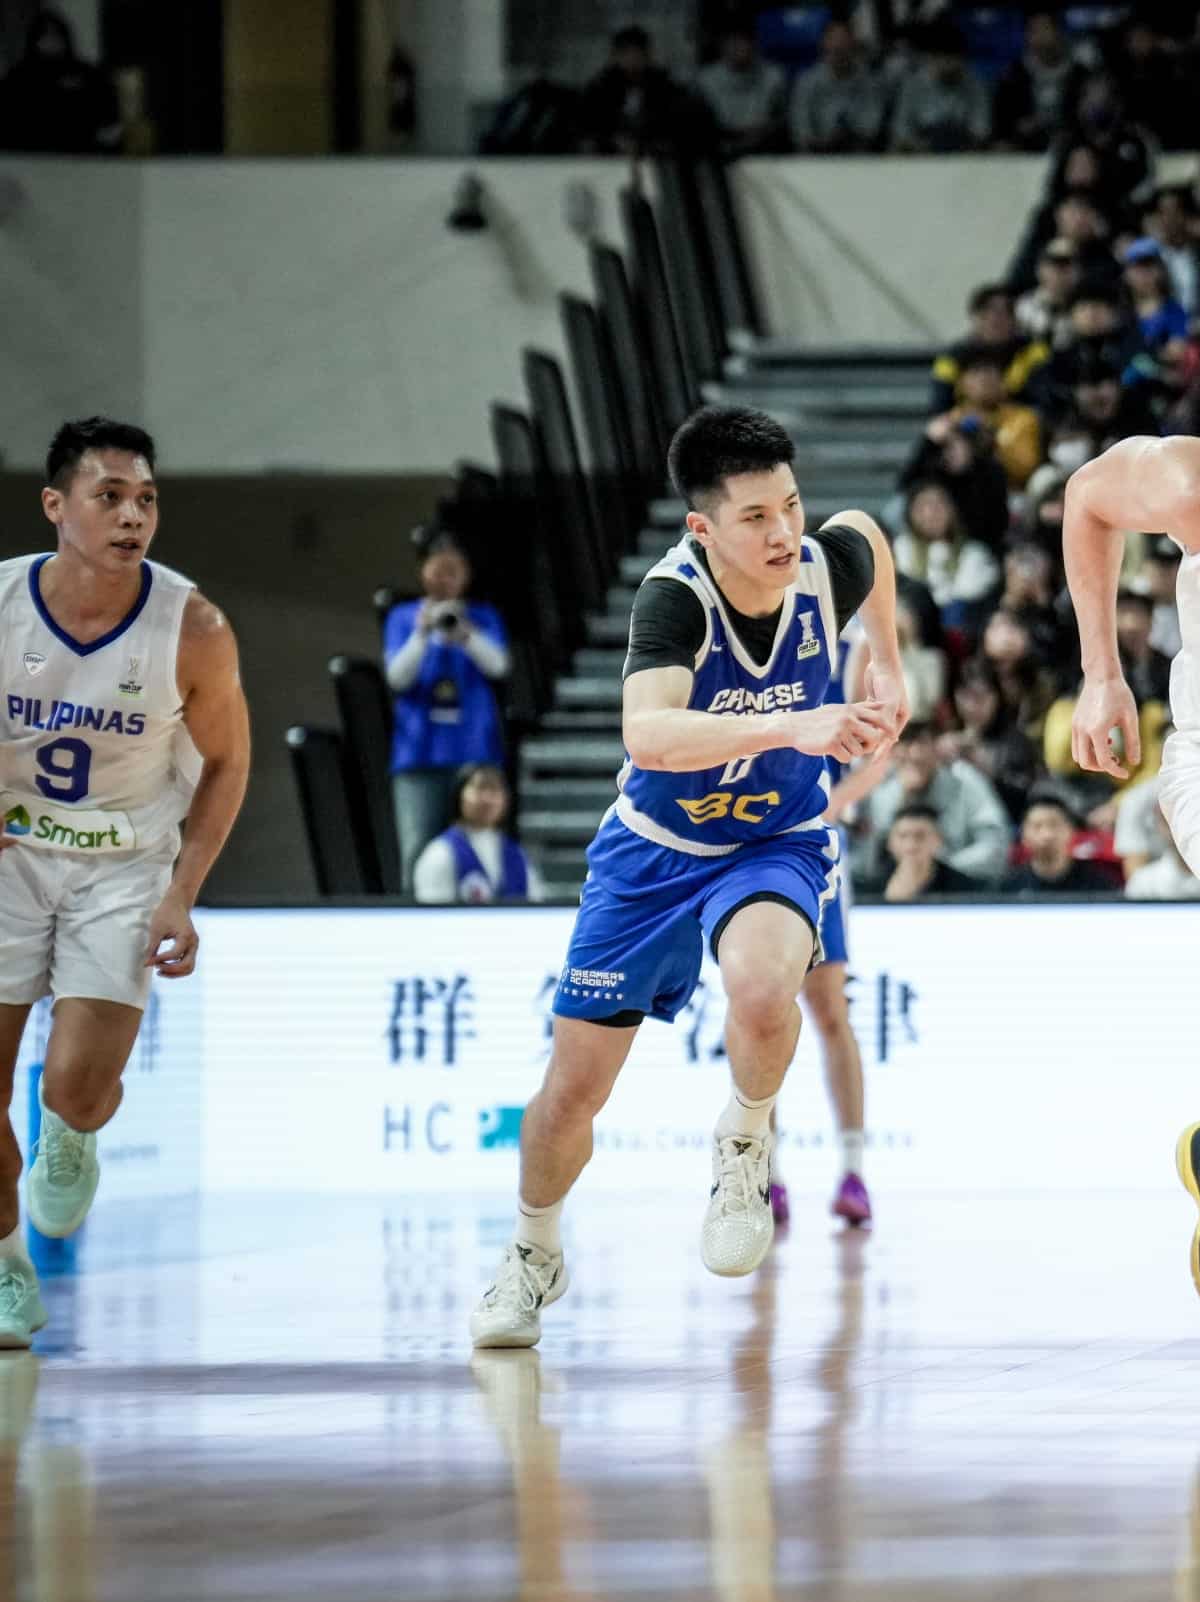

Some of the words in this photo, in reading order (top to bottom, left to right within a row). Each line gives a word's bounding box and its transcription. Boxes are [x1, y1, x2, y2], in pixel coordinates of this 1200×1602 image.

[7, 694, 146, 735] PILIPINAS
[35, 737, 92, 804] 9
[34, 815, 121, 849] Smart
[570, 968, 625, 981] DREAMERS
[570, 976, 617, 988] ACADEMY
